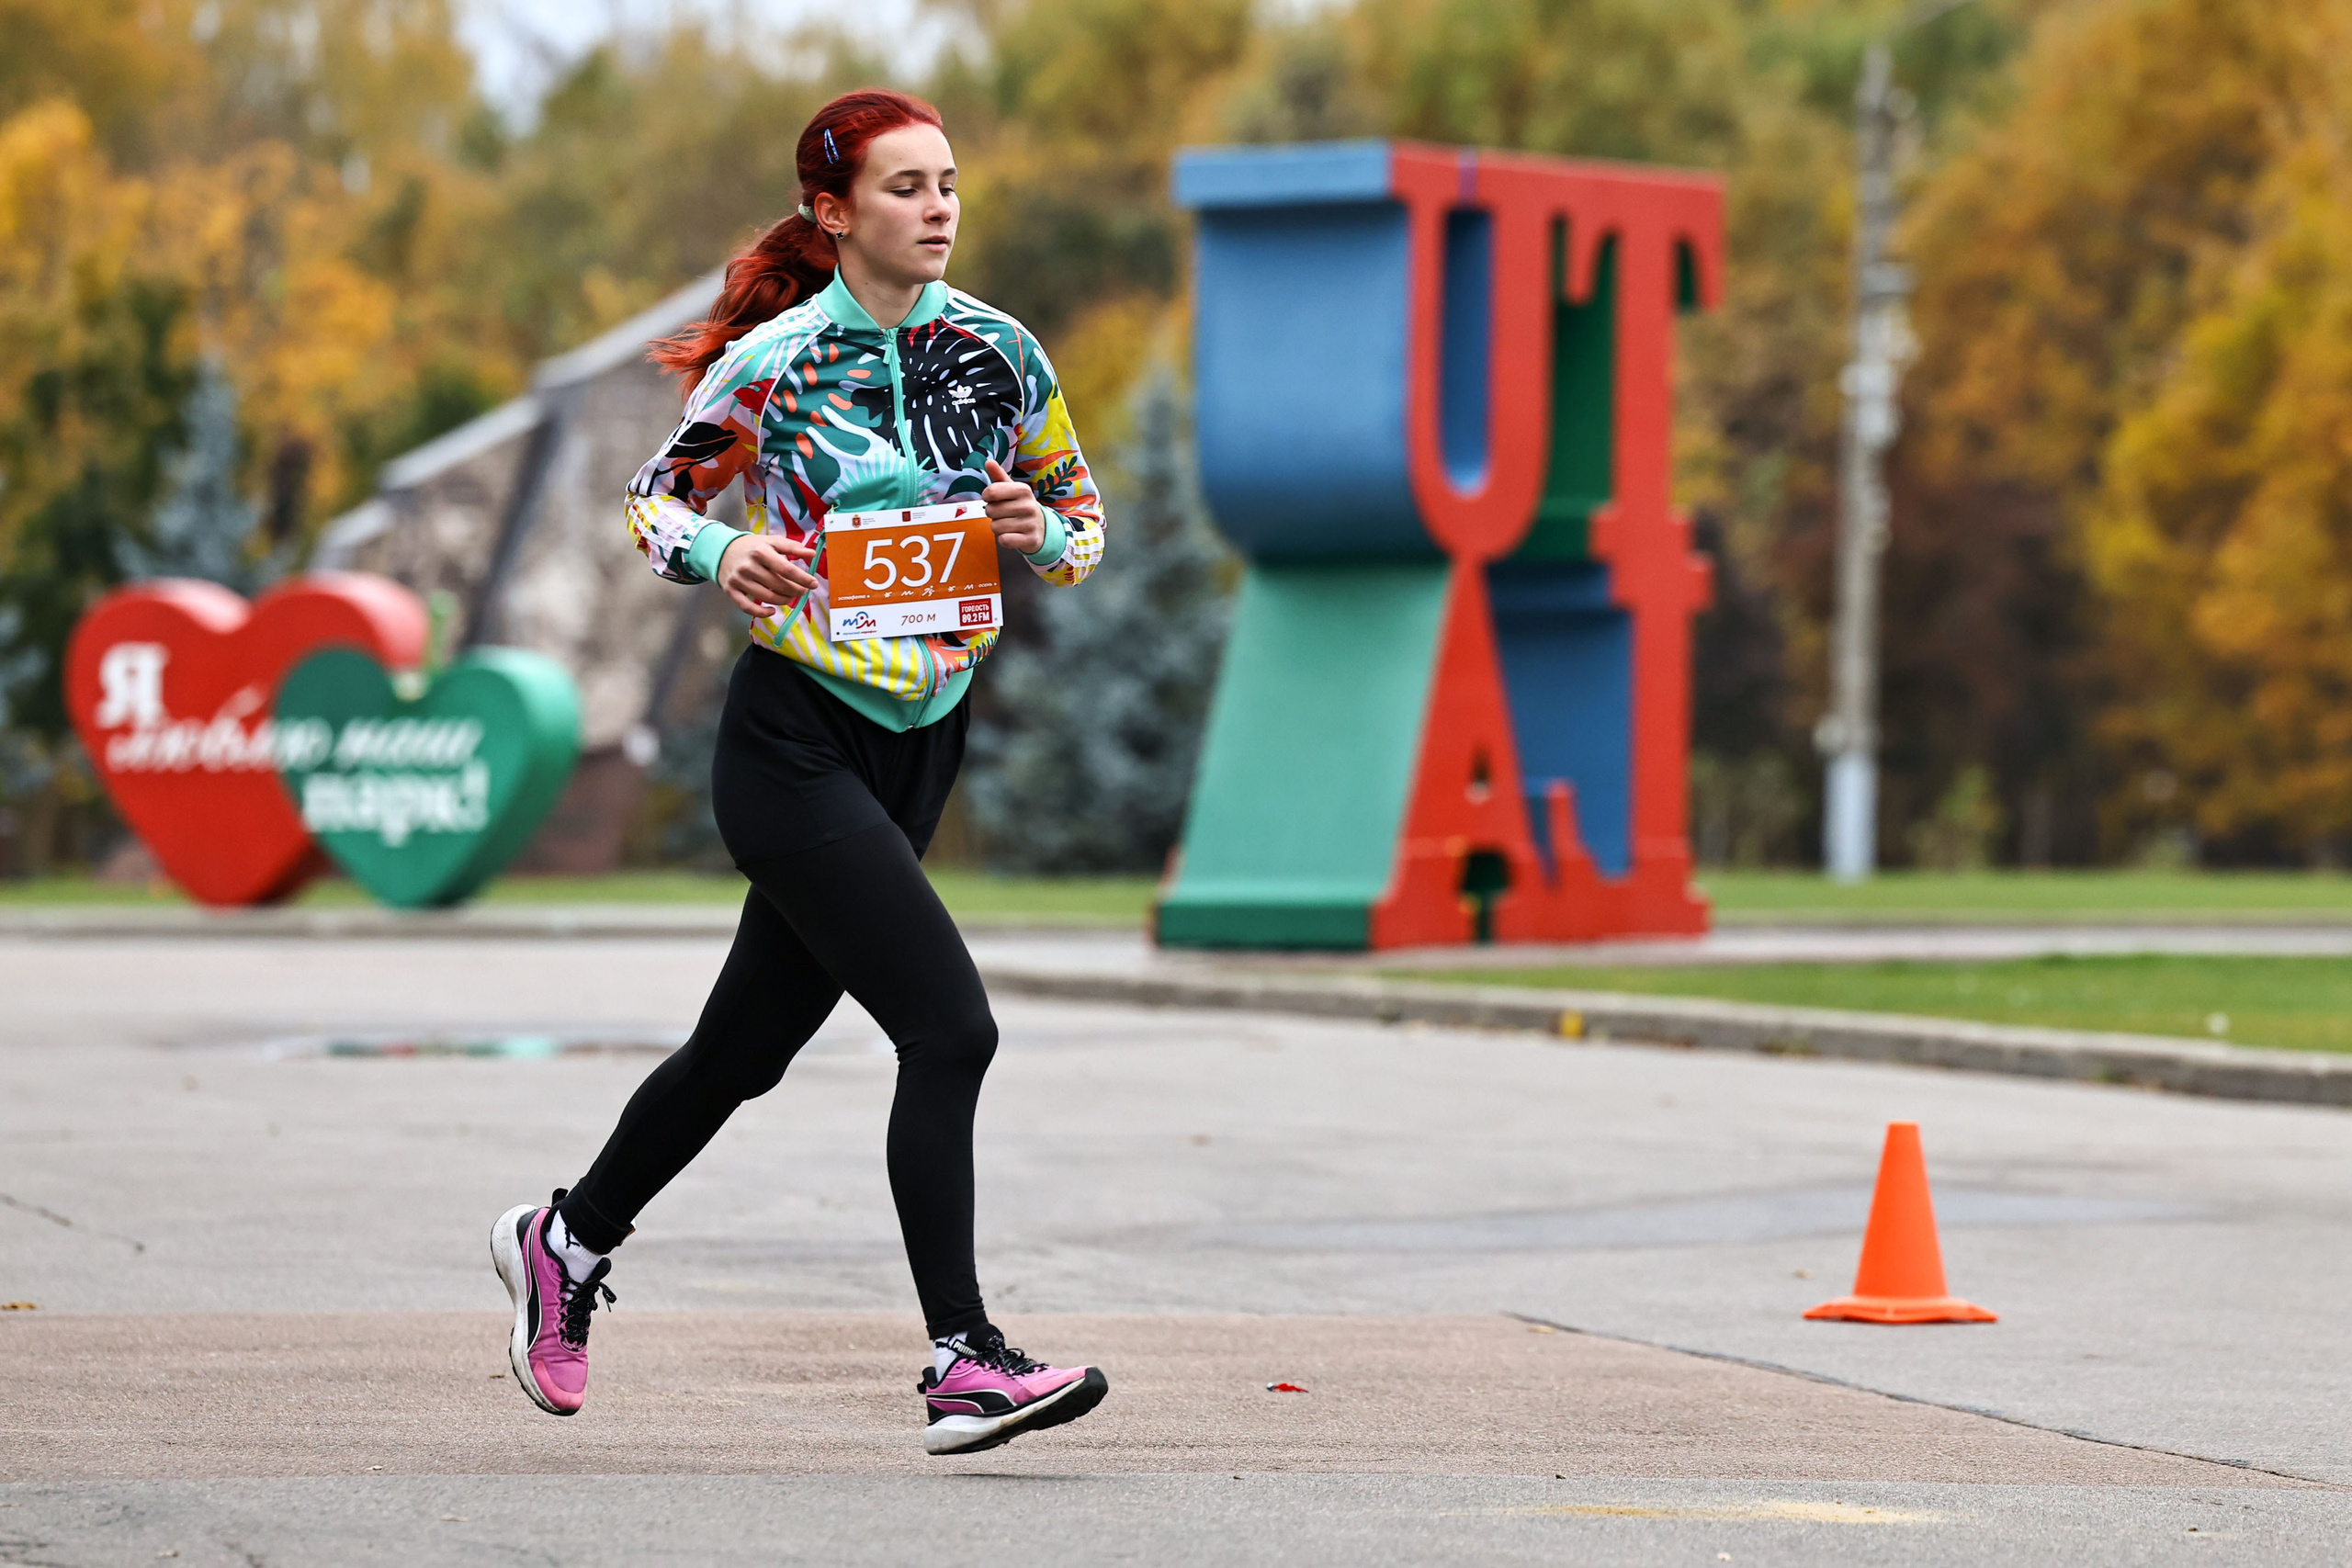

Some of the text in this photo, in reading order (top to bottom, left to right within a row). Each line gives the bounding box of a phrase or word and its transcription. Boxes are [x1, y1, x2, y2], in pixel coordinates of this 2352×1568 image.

[863, 531, 966, 591] 537
[961, 604, 989, 613] ГОРДОСТЬ
[901, 615, 923, 626] 700
[962, 612, 990, 624] 89.2 FM
[96, 641, 168, 728] Я
[302, 759, 491, 847] парк!
[953, 1341, 978, 1356] PUMA
